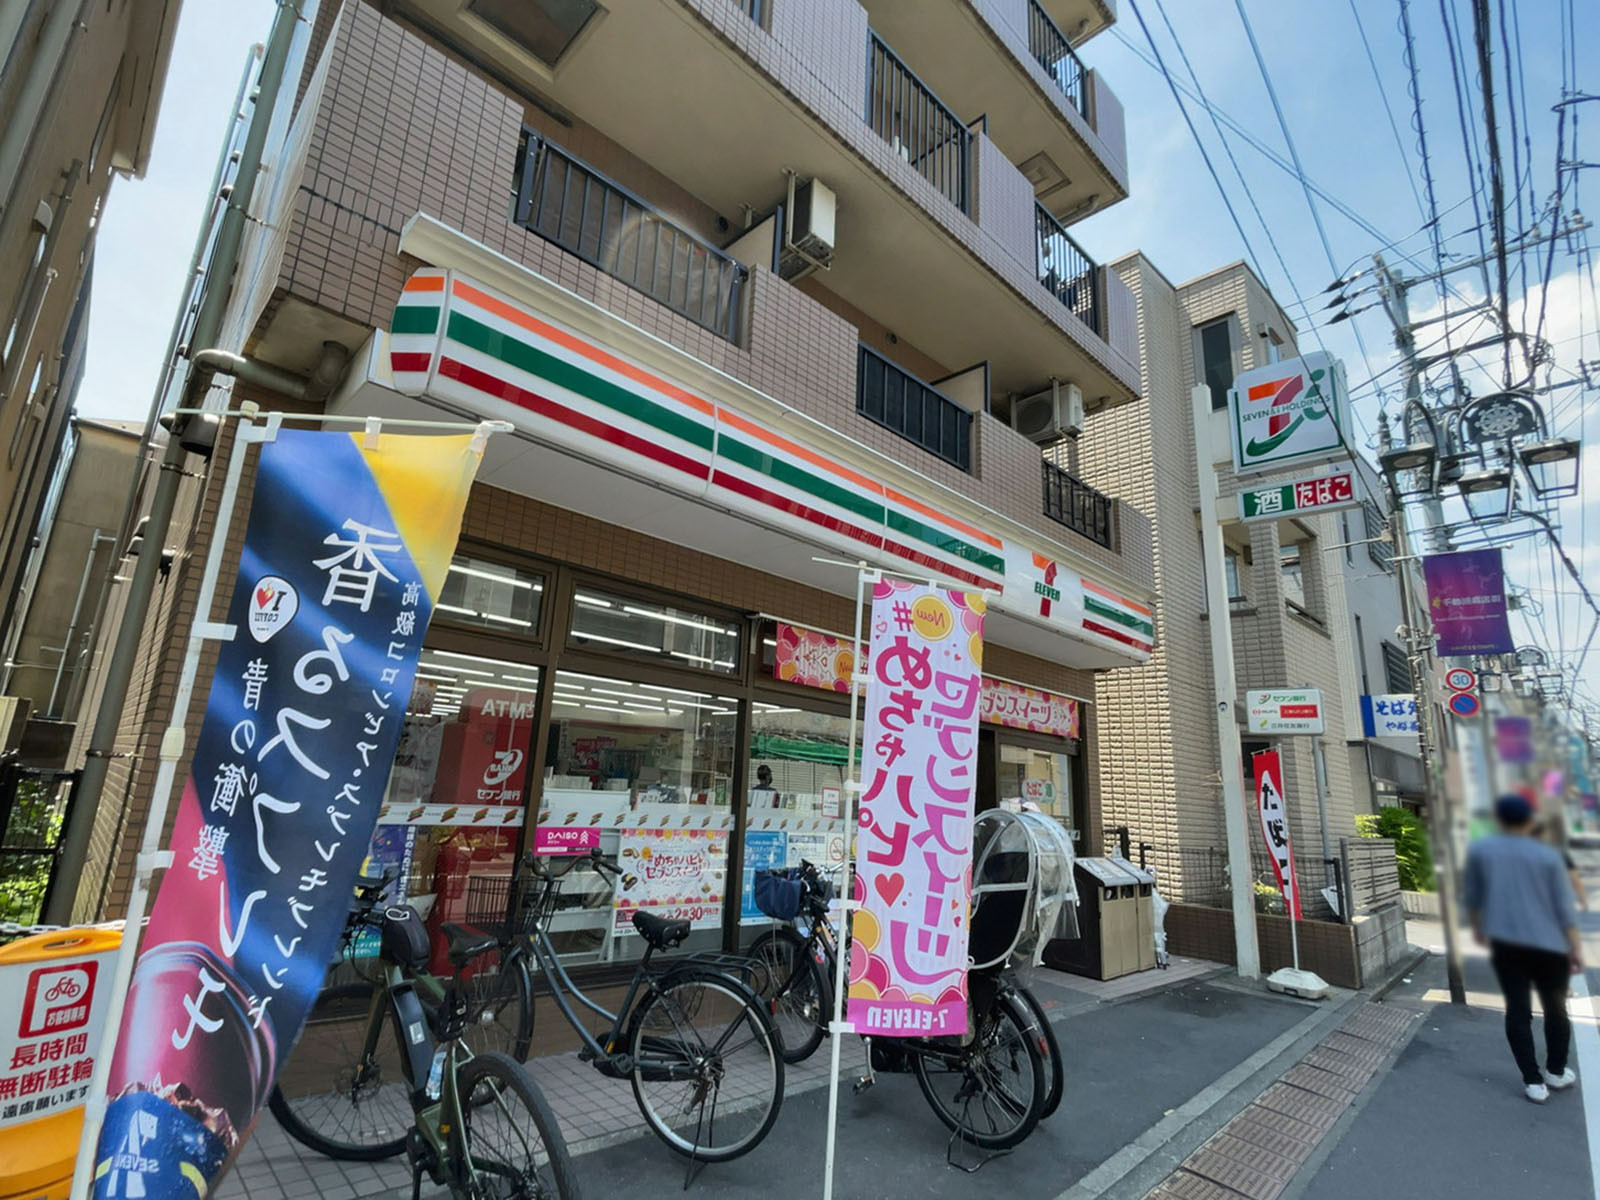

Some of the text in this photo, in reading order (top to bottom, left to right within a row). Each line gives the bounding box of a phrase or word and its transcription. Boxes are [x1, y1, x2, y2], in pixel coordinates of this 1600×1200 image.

[1254, 477, 1350, 515] 酒 たばこ
[1452, 673, 1470, 686] 30
[547, 831, 579, 841] DAISO
[9, 1032, 88, 1070] 長時間
[0, 1056, 94, 1100] 無断駐輪
